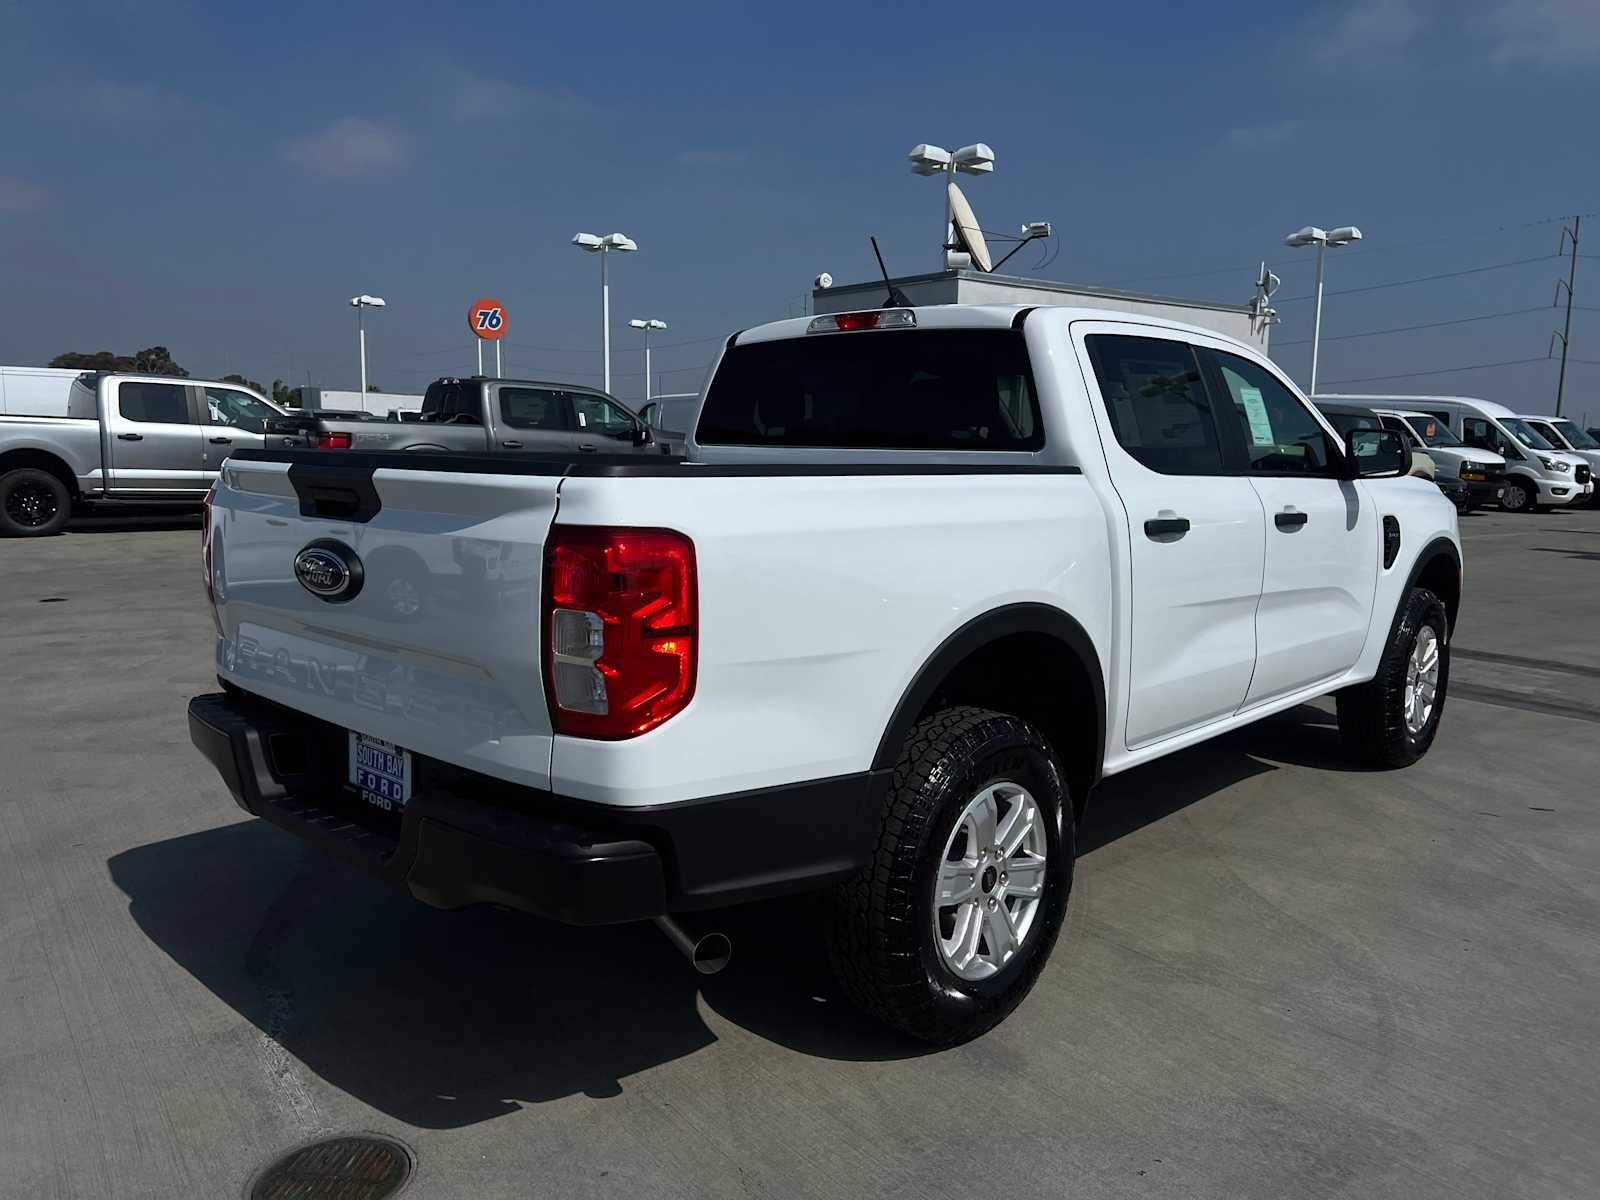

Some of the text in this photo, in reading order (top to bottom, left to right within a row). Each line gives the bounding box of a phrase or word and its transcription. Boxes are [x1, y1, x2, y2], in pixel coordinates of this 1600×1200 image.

[476, 308, 502, 330] 76
[301, 556, 335, 586] Ford
[357, 744, 384, 771] SOUTH
[386, 755, 403, 777] BAY
[357, 768, 402, 800] FORD
[362, 789, 392, 811] FORD
